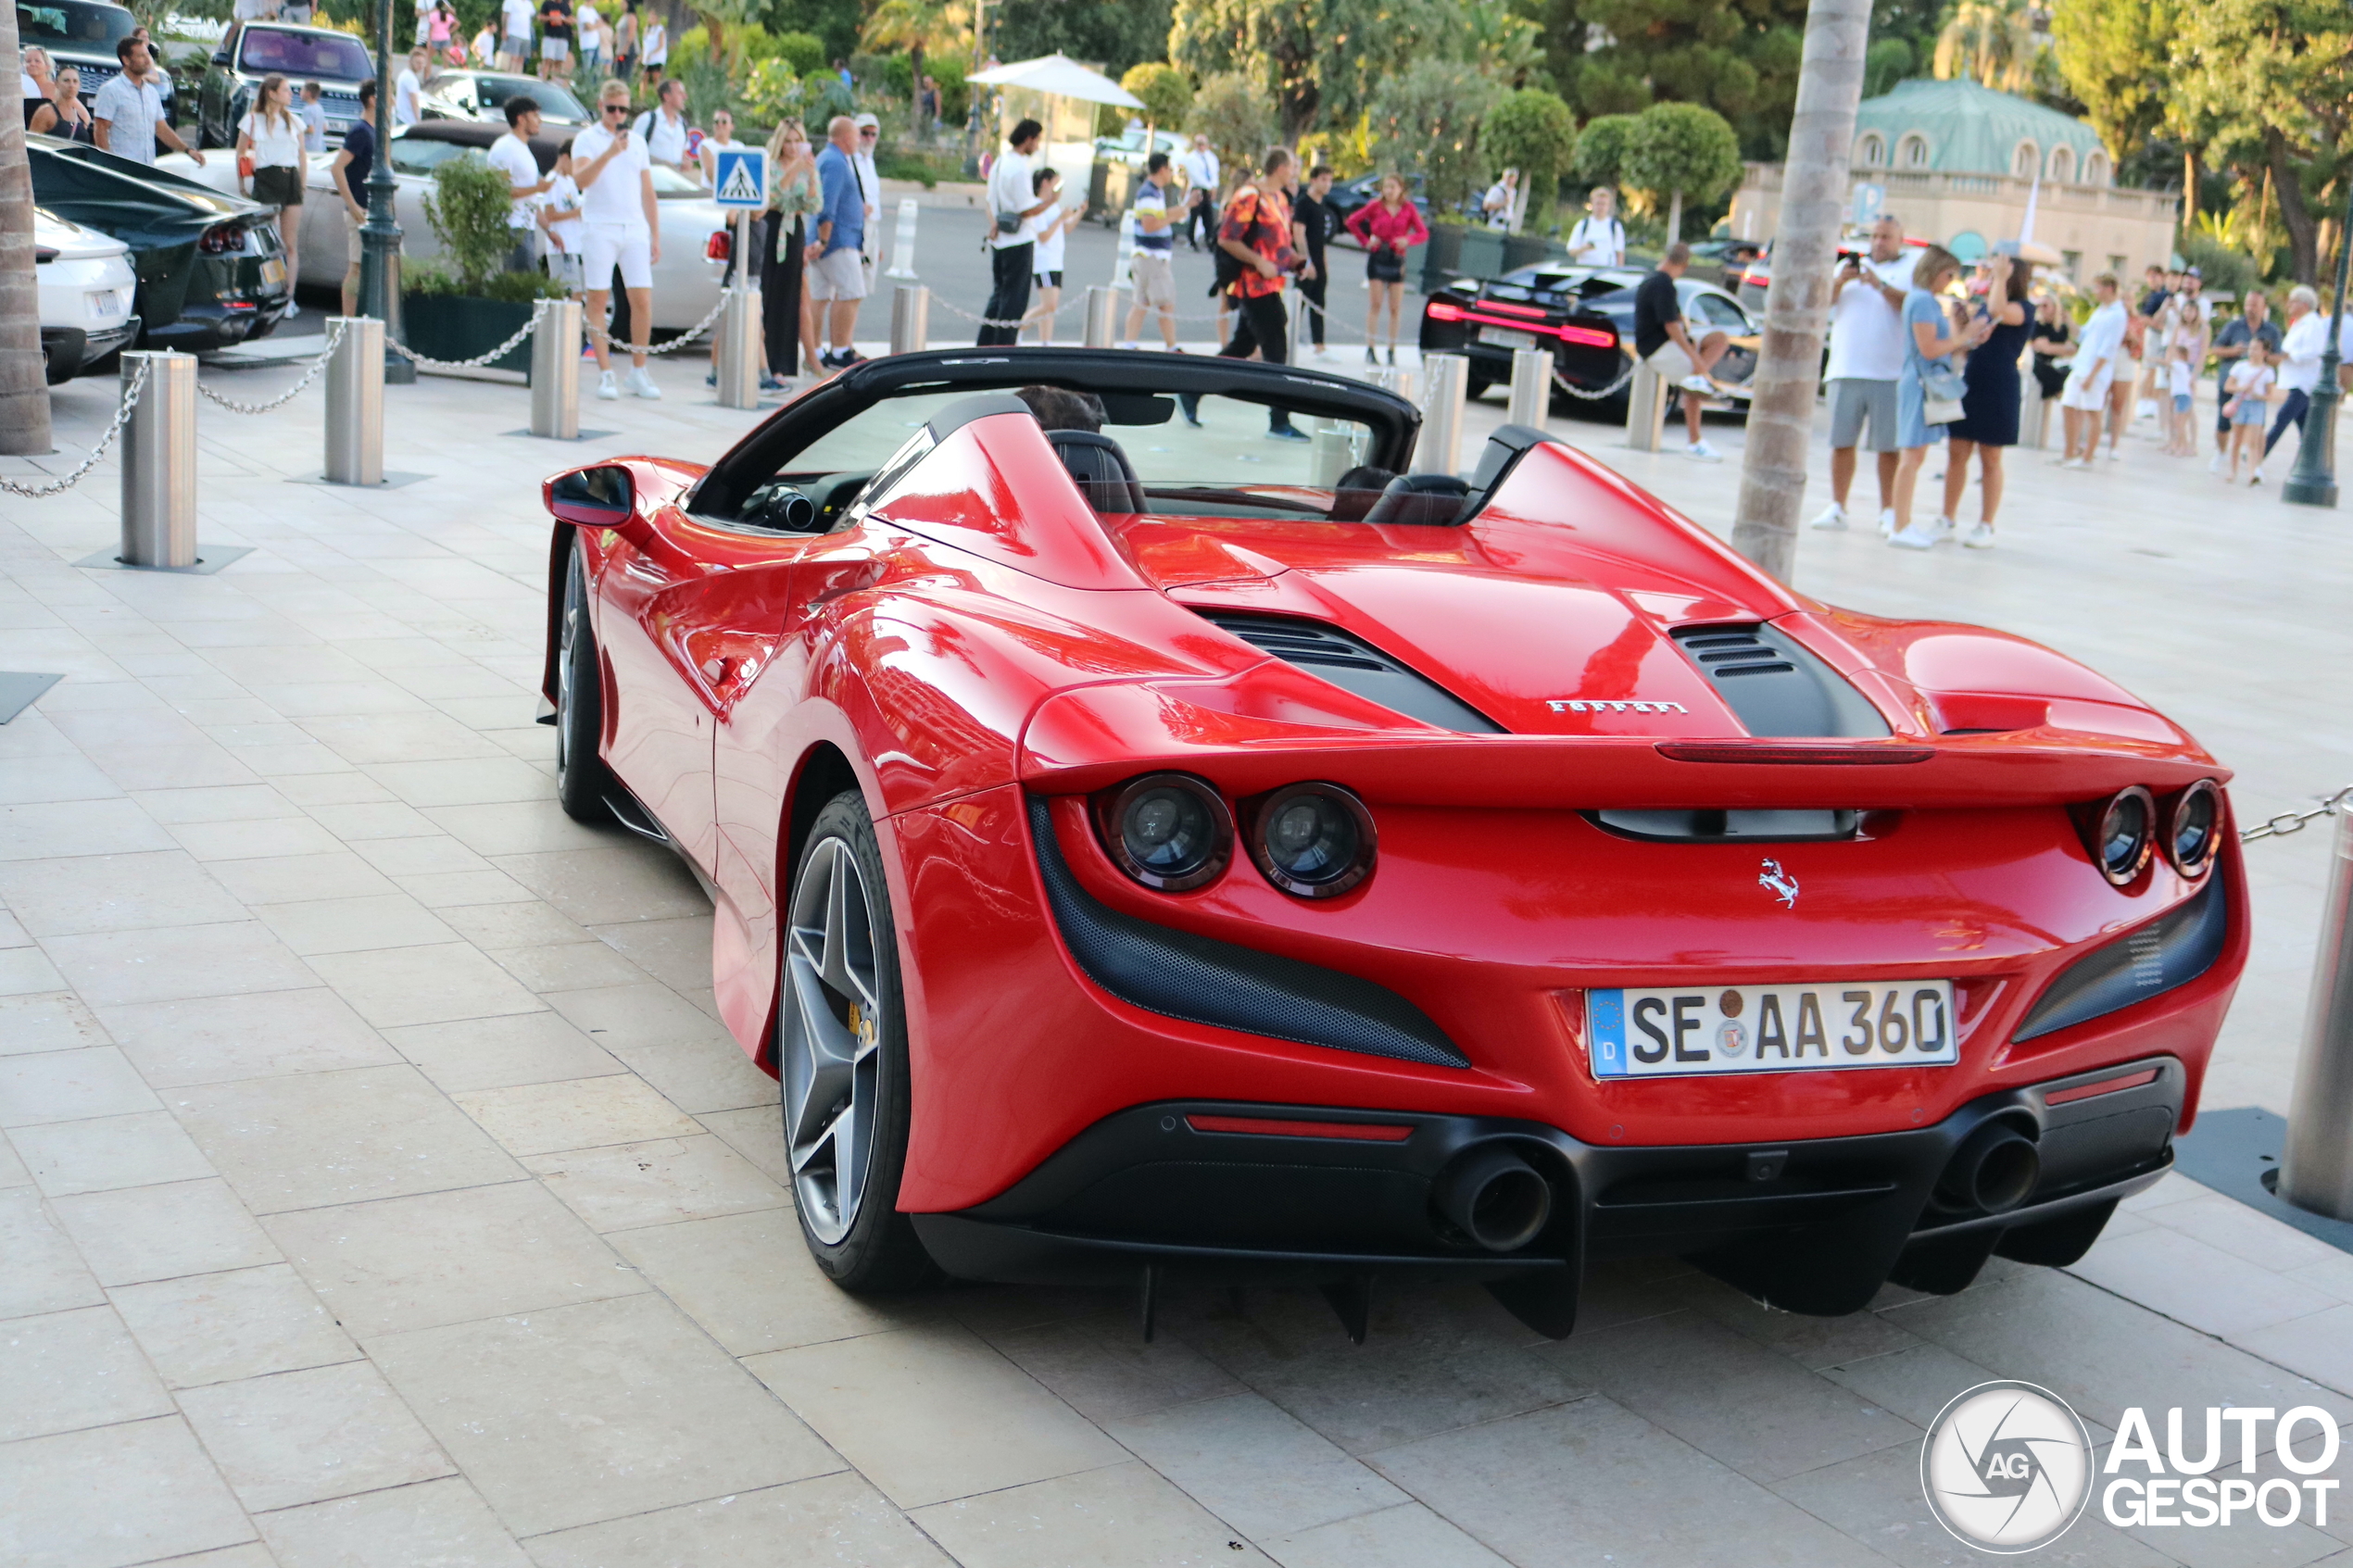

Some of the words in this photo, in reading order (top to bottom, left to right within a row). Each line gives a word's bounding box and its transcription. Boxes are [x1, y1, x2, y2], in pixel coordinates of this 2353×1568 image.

[1546, 700, 1689, 713] Ferrari
[1633, 996, 1710, 1063] SE
[1755, 993, 1829, 1059] AA
[1843, 989, 1944, 1055] 360
[1604, 1042, 1617, 1060] D
